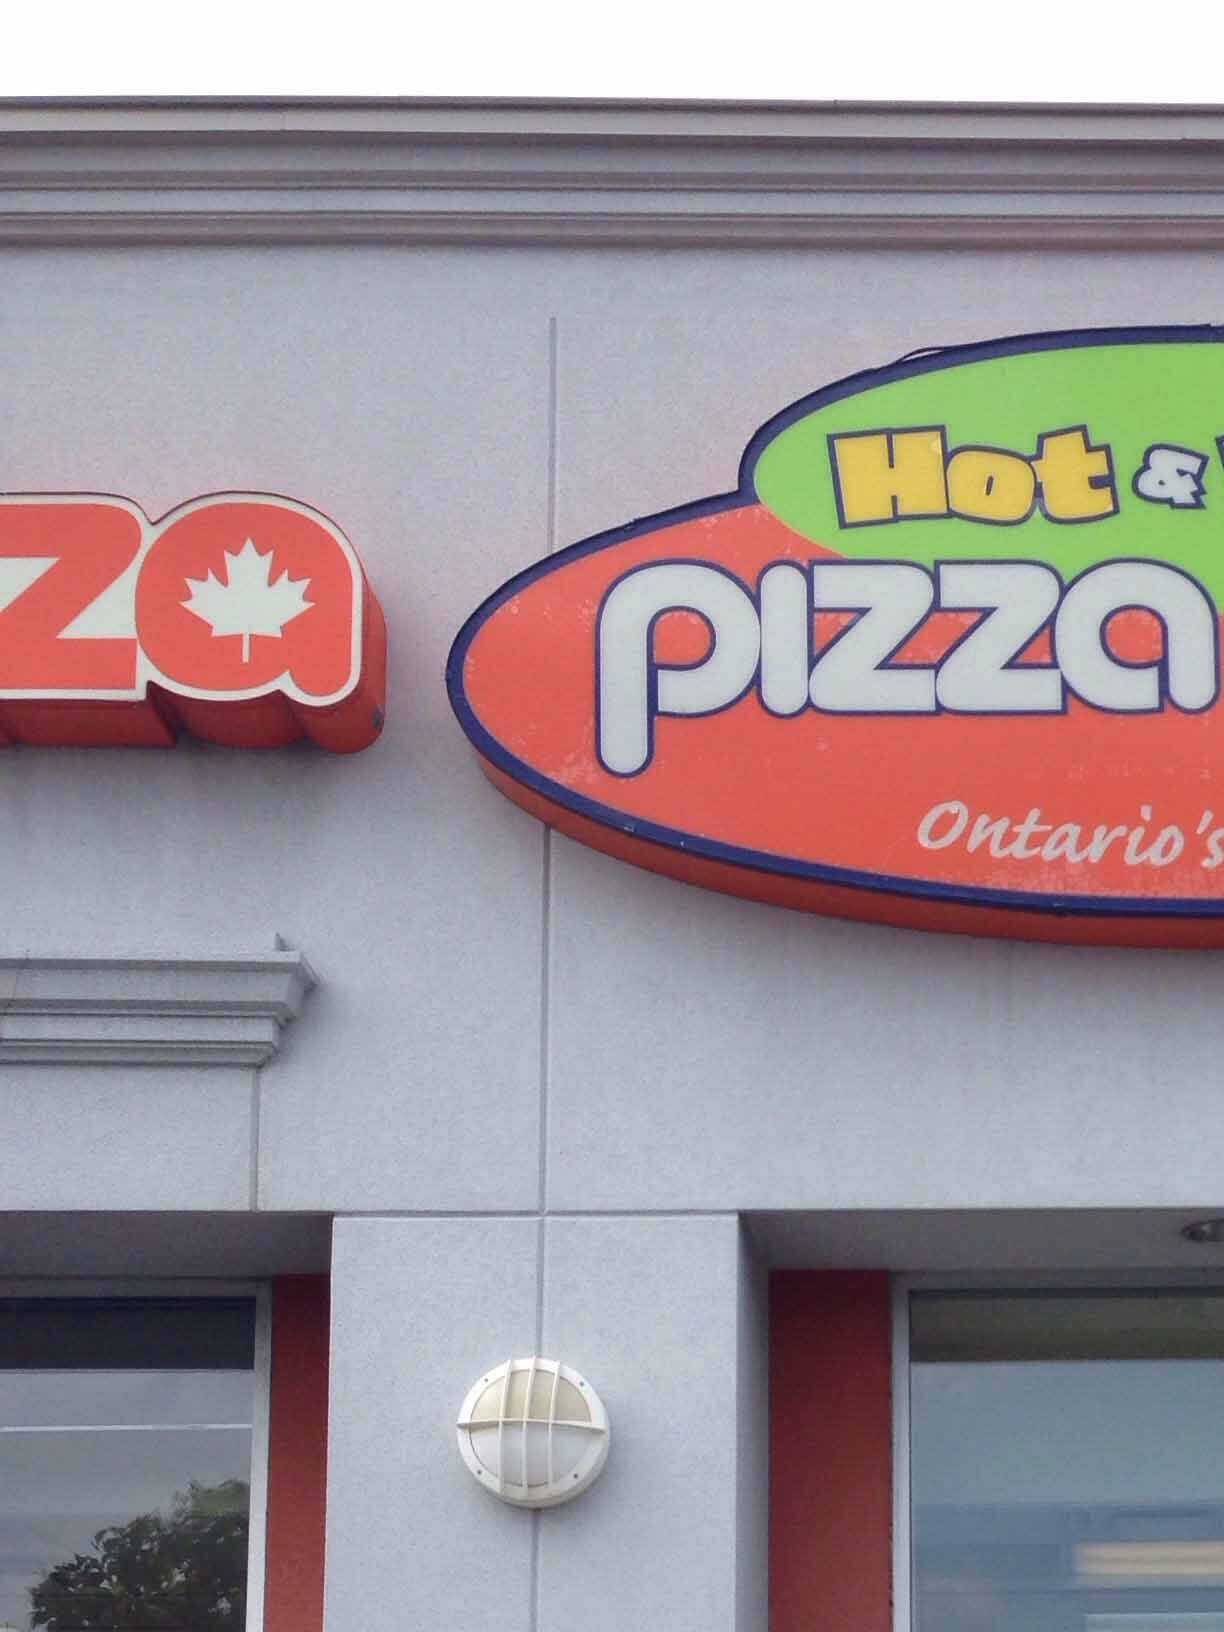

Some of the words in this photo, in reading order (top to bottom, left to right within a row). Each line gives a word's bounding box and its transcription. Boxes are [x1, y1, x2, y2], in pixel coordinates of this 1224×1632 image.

[826, 424, 1119, 529] Hot
[1132, 444, 1208, 510] &
[594, 557, 1221, 777] pizza
